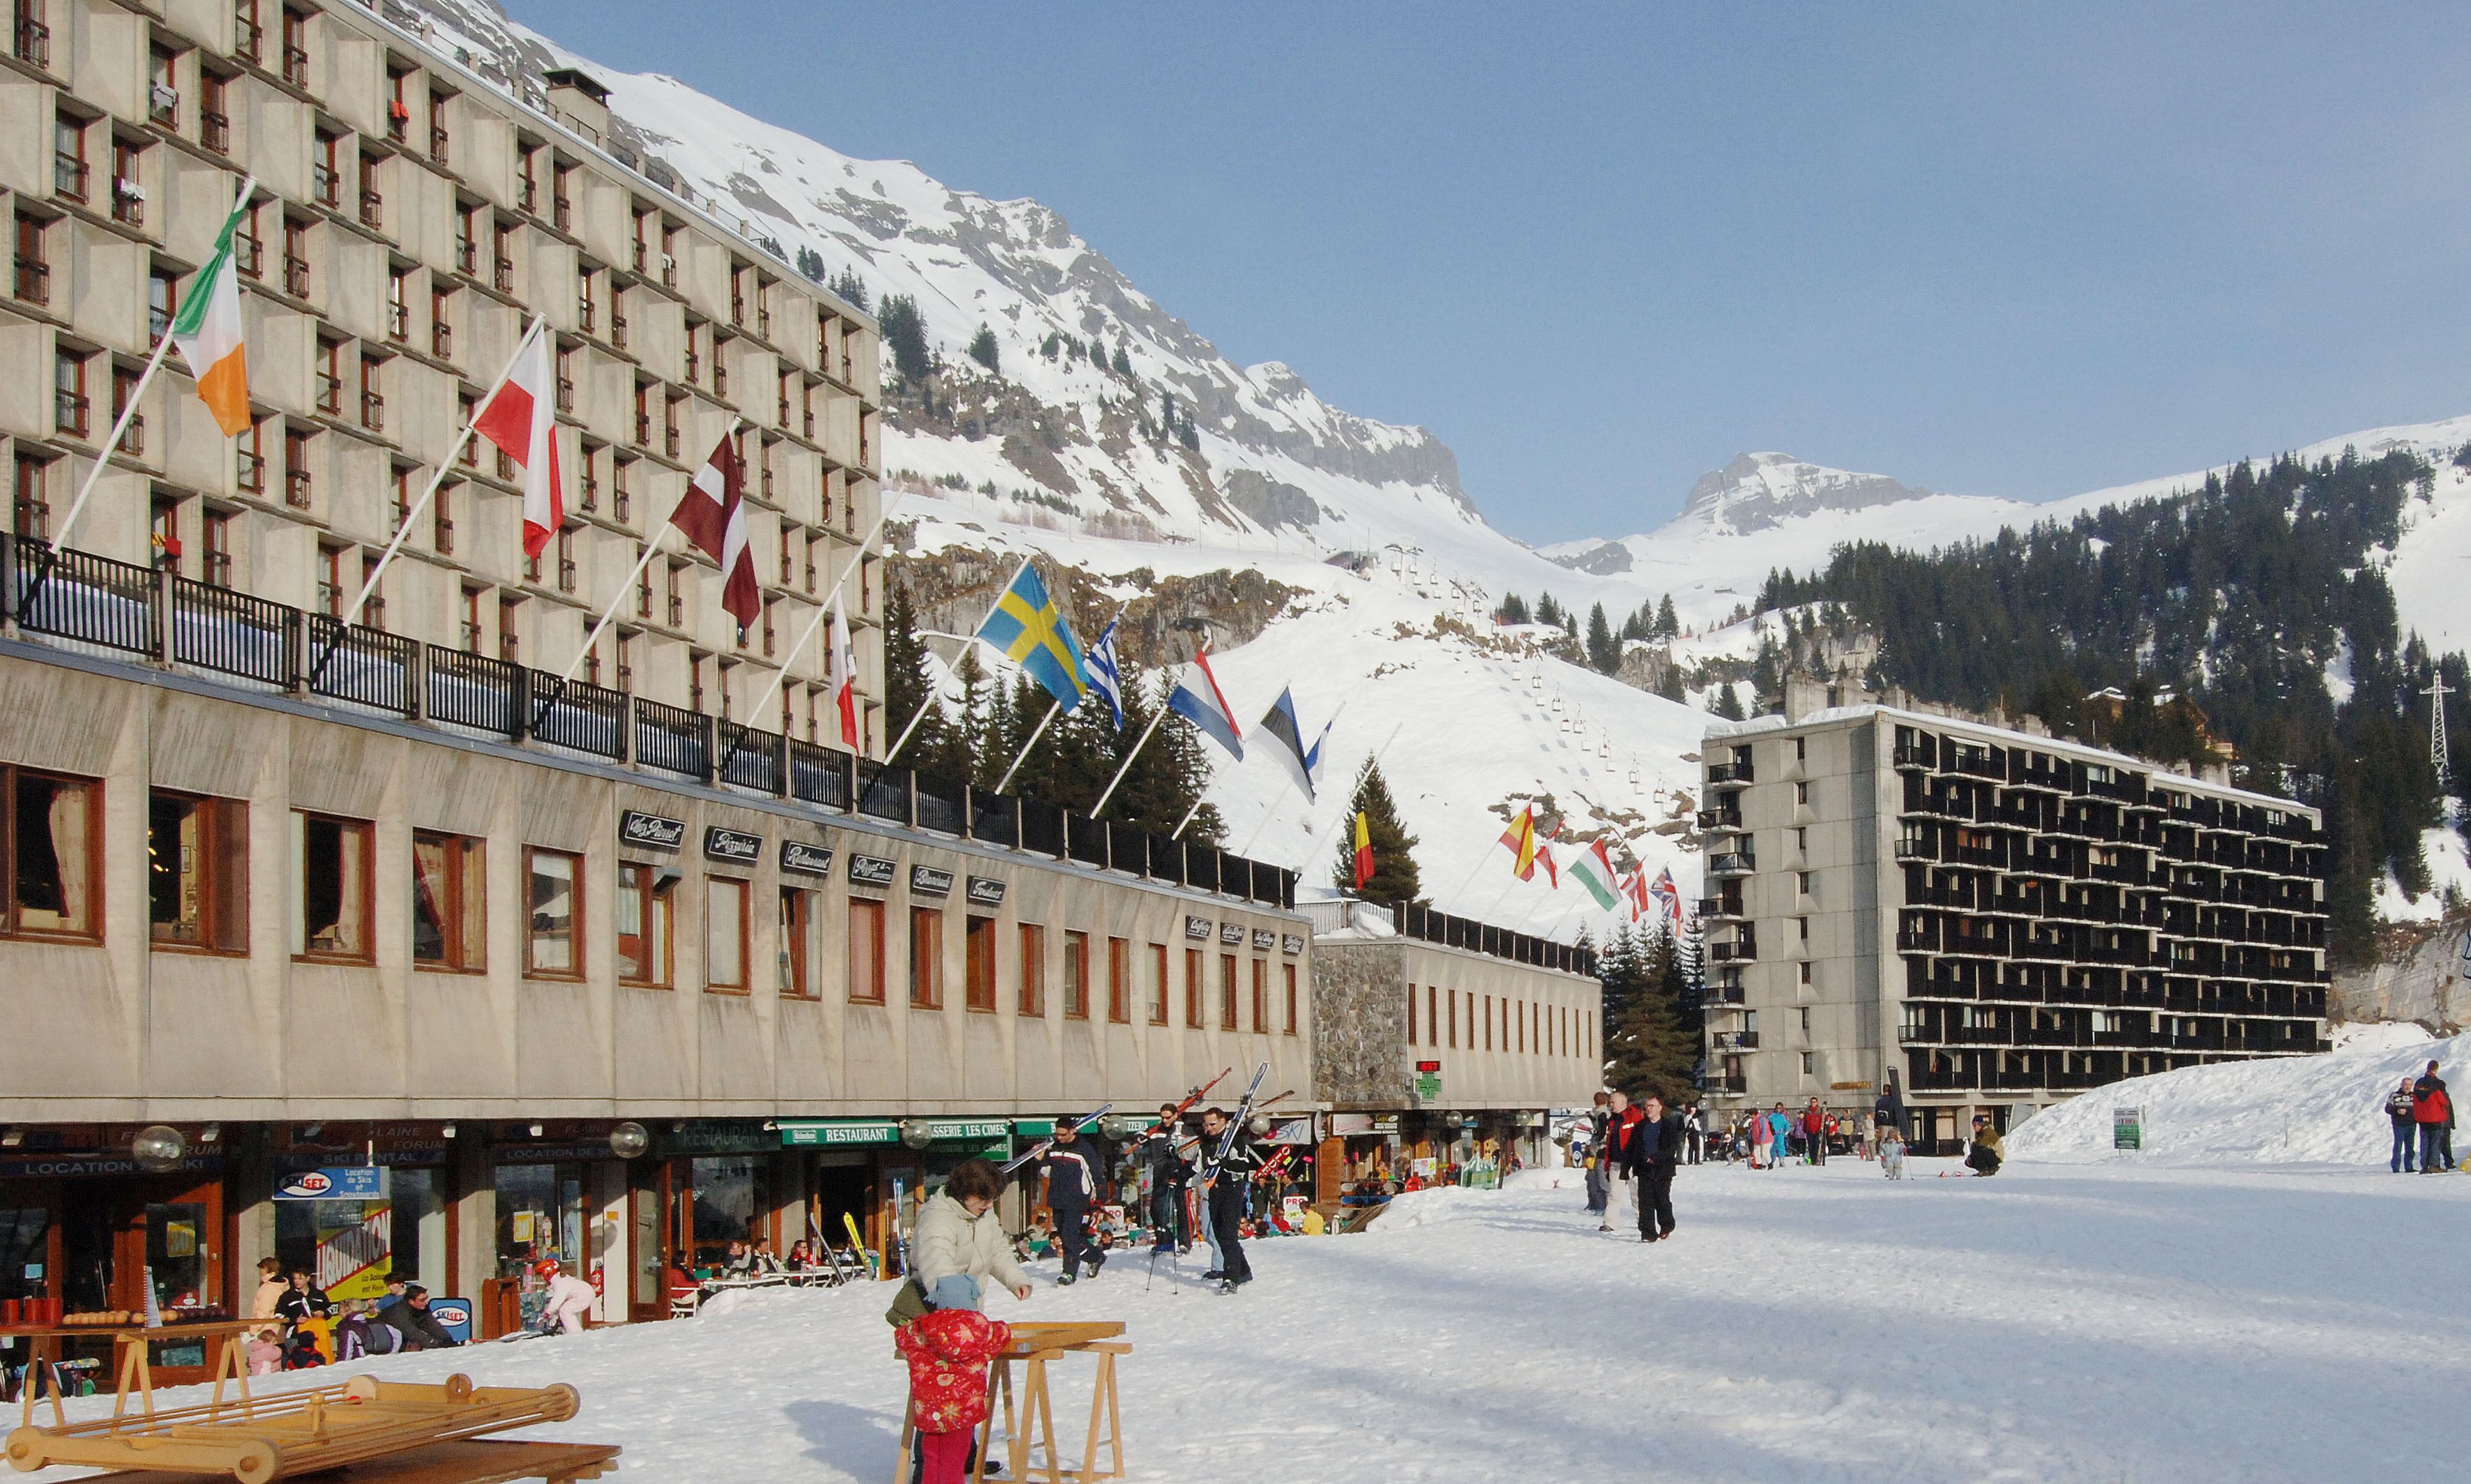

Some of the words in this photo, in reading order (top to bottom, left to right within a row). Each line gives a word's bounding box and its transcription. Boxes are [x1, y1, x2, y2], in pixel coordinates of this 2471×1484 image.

[715, 833, 755, 854] Pizzeria
[931, 1125, 962, 1137] SSERIE
[966, 1125, 981, 1137] LES
[982, 1123, 1006, 1135] CIMES
[1127, 1121, 1149, 1131] ZZERIA
[826, 1128, 888, 1141] RESTAURANT
[186, 1144, 222, 1155] RUM
[983, 1144, 1007, 1152] CIMES
[354, 1153, 416, 1163] RNTAL
[507, 1149, 574, 1159] LOCATION
[25, 1160, 133, 1175] LOCATION
[436, 1310, 463, 1322] SKISET
